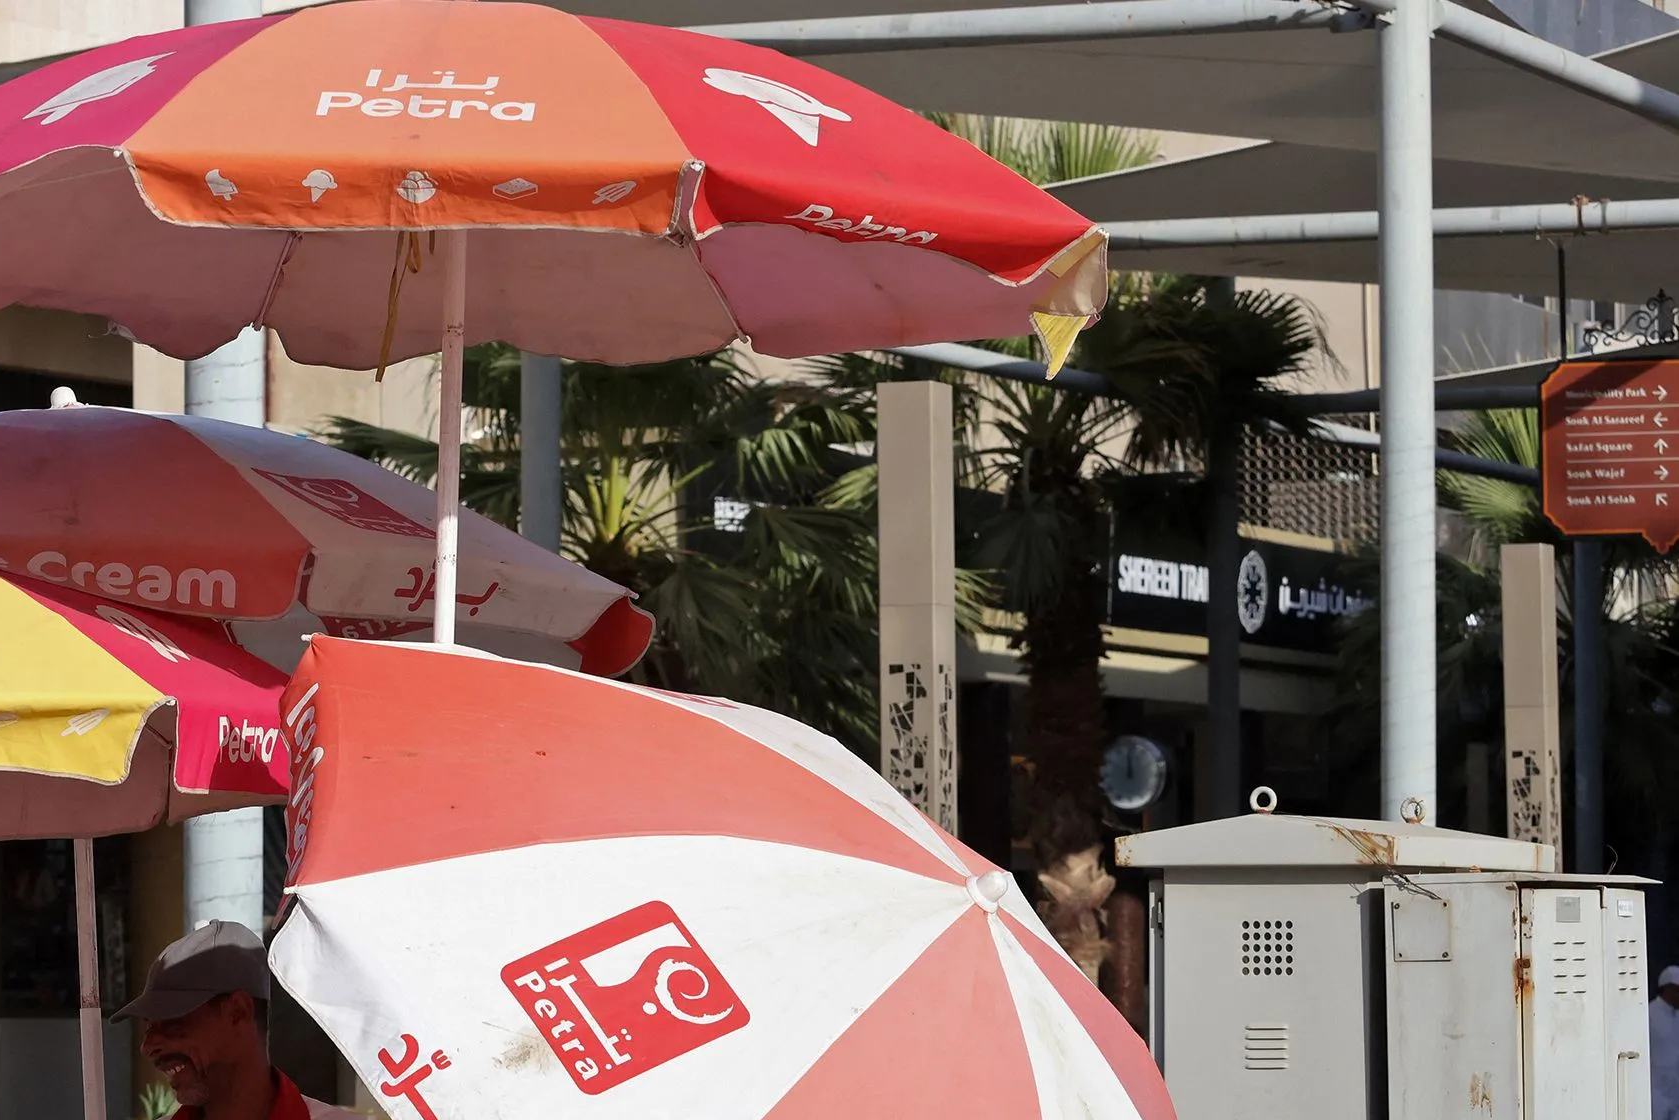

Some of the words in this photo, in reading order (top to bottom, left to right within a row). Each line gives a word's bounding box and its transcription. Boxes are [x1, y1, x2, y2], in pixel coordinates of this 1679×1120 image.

[365, 69, 499, 95] بترا
[315, 91, 536, 121] Petra
[783, 204, 939, 244] Petra
[1625, 387, 1647, 398] Park
[1565, 416, 1590, 426] Souk
[1591, 415, 1603, 425] Al
[1566, 442, 1594, 453] Safat
[1595, 442, 1633, 454] Square
[1566, 470, 1592, 480] Souk
[1594, 468, 1625, 480] Wajef
[1566, 495, 1591, 506] Souk
[1593, 494, 1606, 505] Al
[26, 550, 236, 609] Cream
[1118, 554, 1179, 600] SHEREEN
[1278, 576, 1328, 620] شيرين
[218, 716, 279, 764] Petra
[513, 969, 600, 1081] Petra
[544, 957, 633, 1070] بترا
